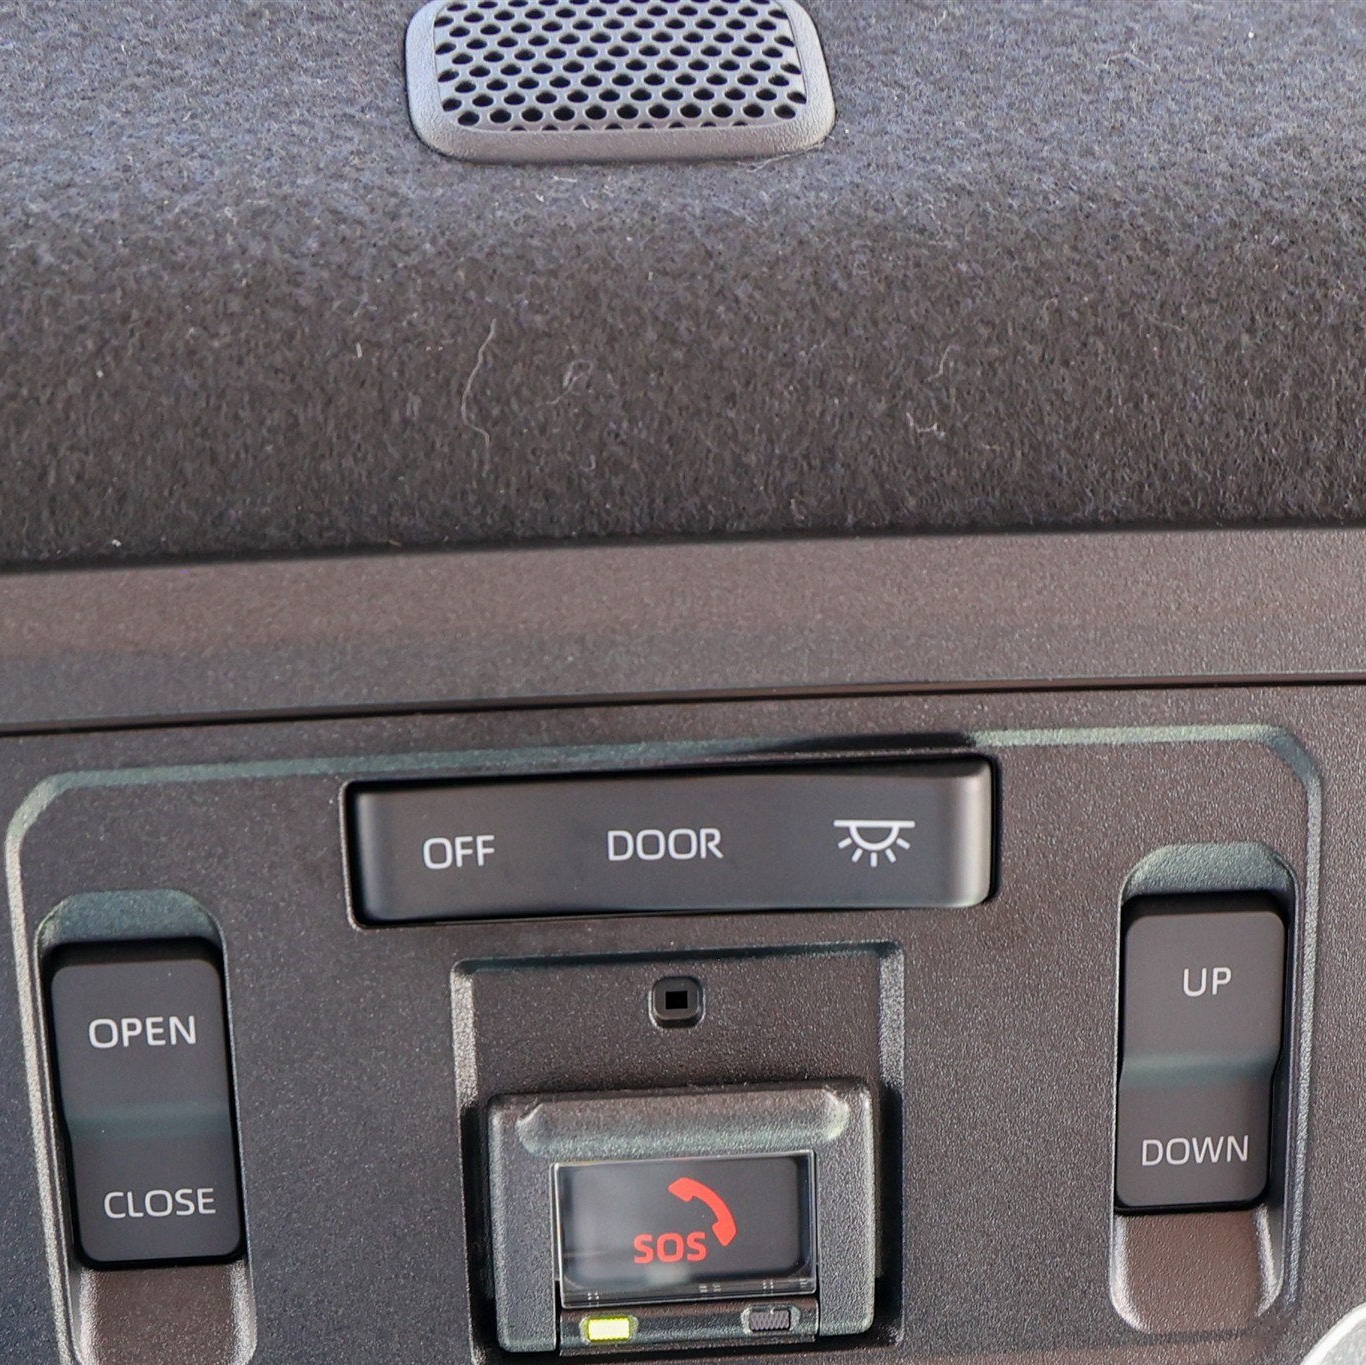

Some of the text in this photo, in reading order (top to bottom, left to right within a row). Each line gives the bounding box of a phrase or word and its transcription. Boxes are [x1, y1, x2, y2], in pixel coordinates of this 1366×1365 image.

[422, 834, 495, 870] OFF
[606, 827, 724, 862] DOOR
[1182, 966, 1233, 997] UP
[88, 1015, 197, 1049] OPEN
[1141, 1134, 1250, 1167] DOWN
[102, 1187, 217, 1220] CLOSE
[633, 1231, 708, 1264] SOS
